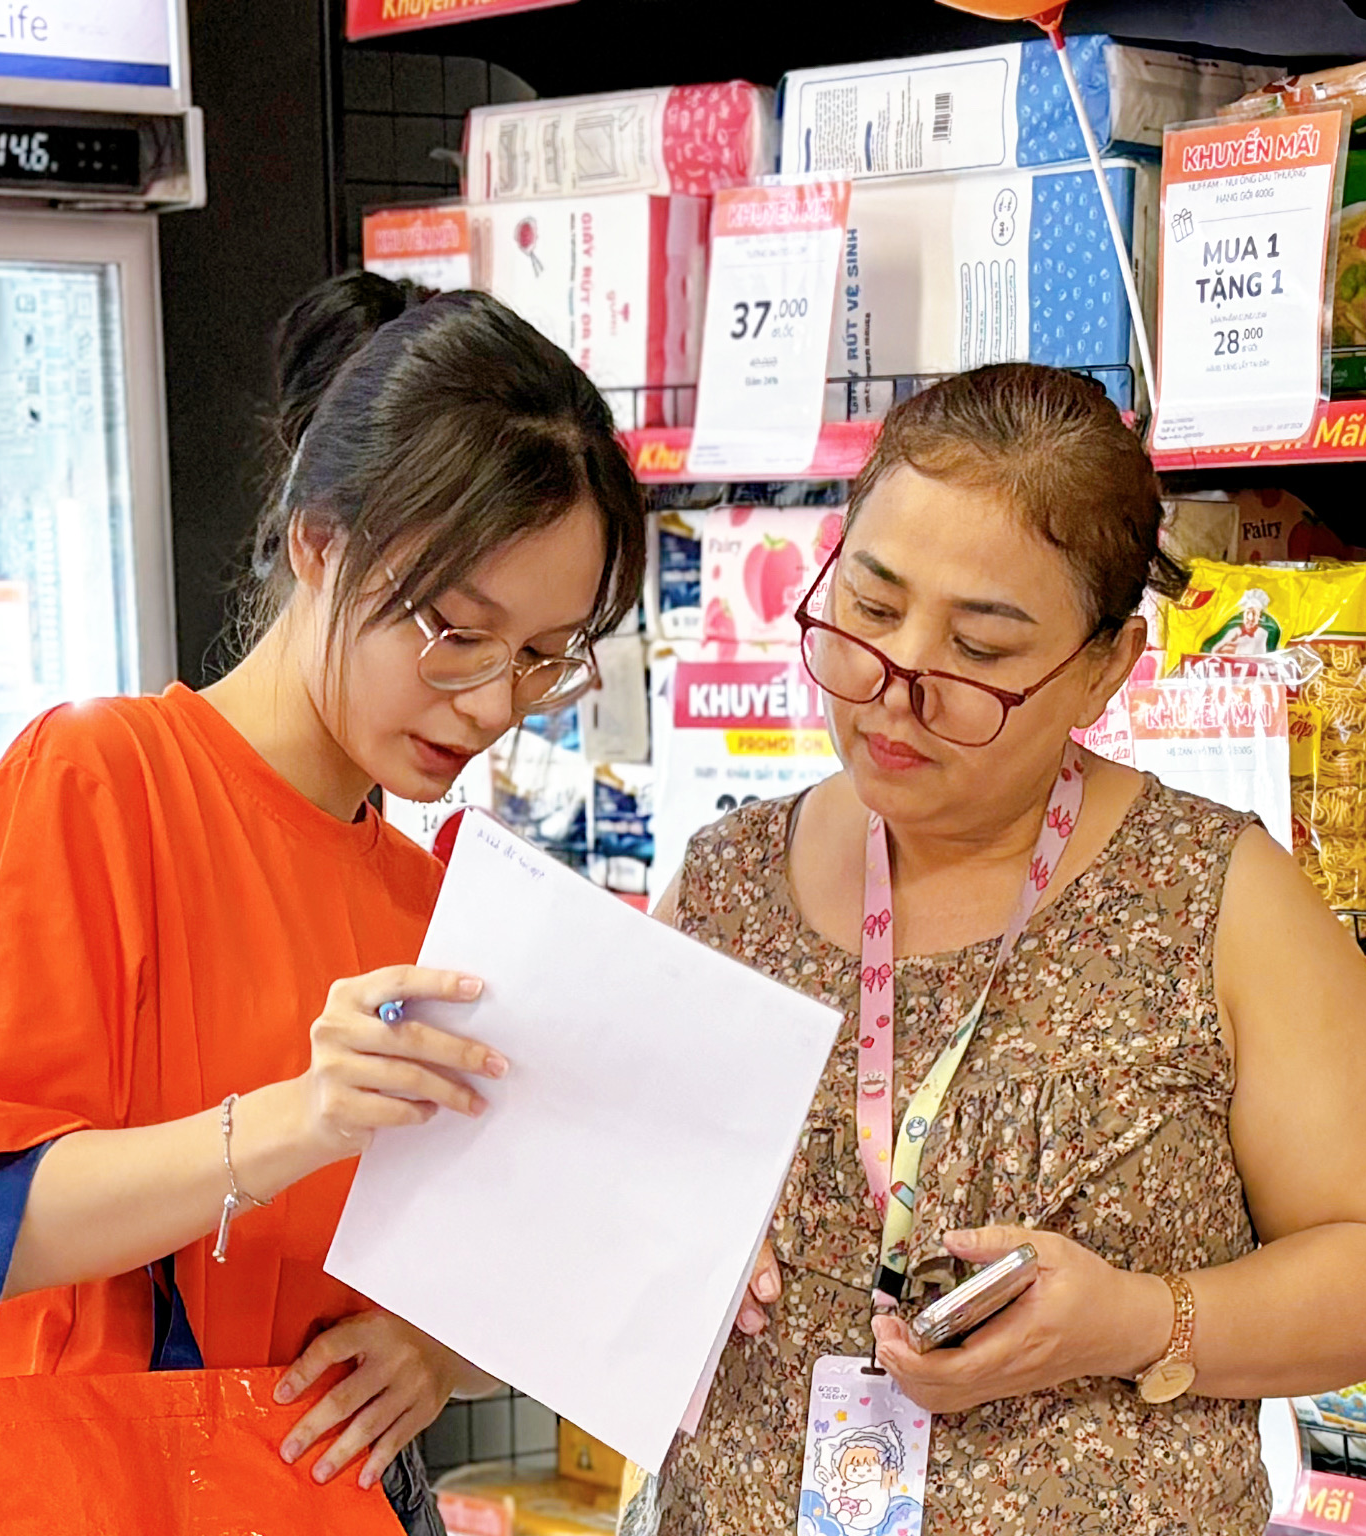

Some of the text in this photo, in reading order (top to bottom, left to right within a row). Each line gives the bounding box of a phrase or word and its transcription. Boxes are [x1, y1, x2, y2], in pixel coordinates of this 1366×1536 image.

[1183, 124, 1320, 173] KHUYẾN MÃI
[846, 228, 859, 277] SINH
[1203, 232, 1280, 268] MUA 1
[1195, 269, 1284, 309] TẶNG 1
[708, 537, 741, 557] Fairy
[1243, 519, 1282, 542] Fairy
[689, 671, 808, 719] KHUYẾN
[1302, 1474, 1353, 1523] Mãi
